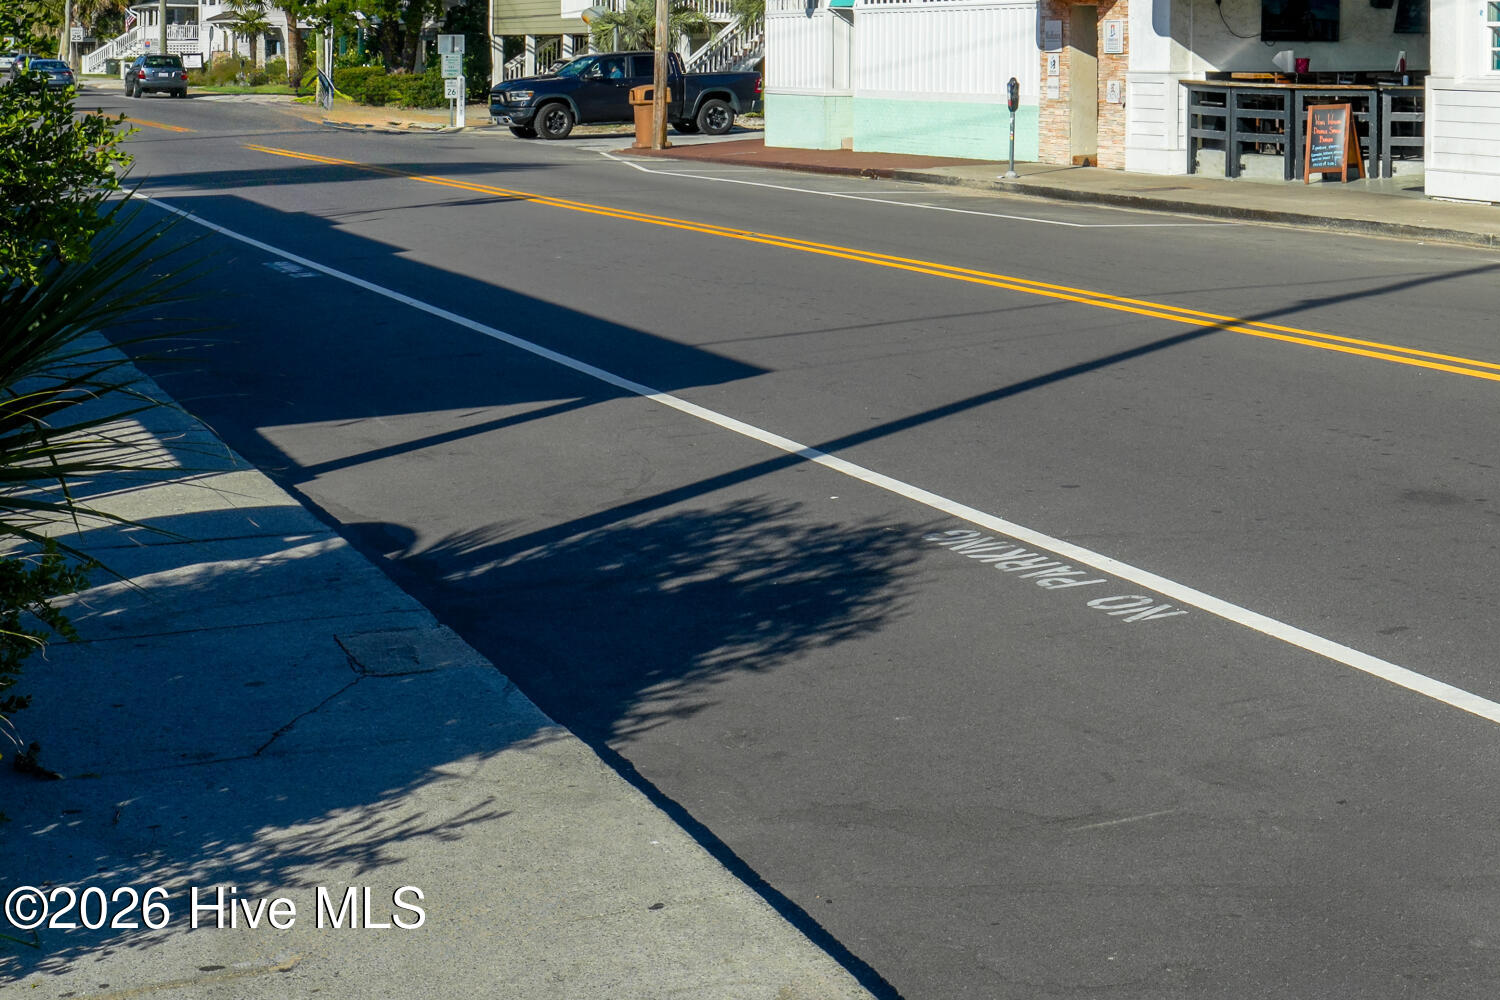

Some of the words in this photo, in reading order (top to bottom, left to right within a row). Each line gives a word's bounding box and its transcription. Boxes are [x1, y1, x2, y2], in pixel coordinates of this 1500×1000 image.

[447, 88, 456, 96] 26
[921, 530, 1107, 590] PARKING
[1087, 595, 1188, 623] NO
